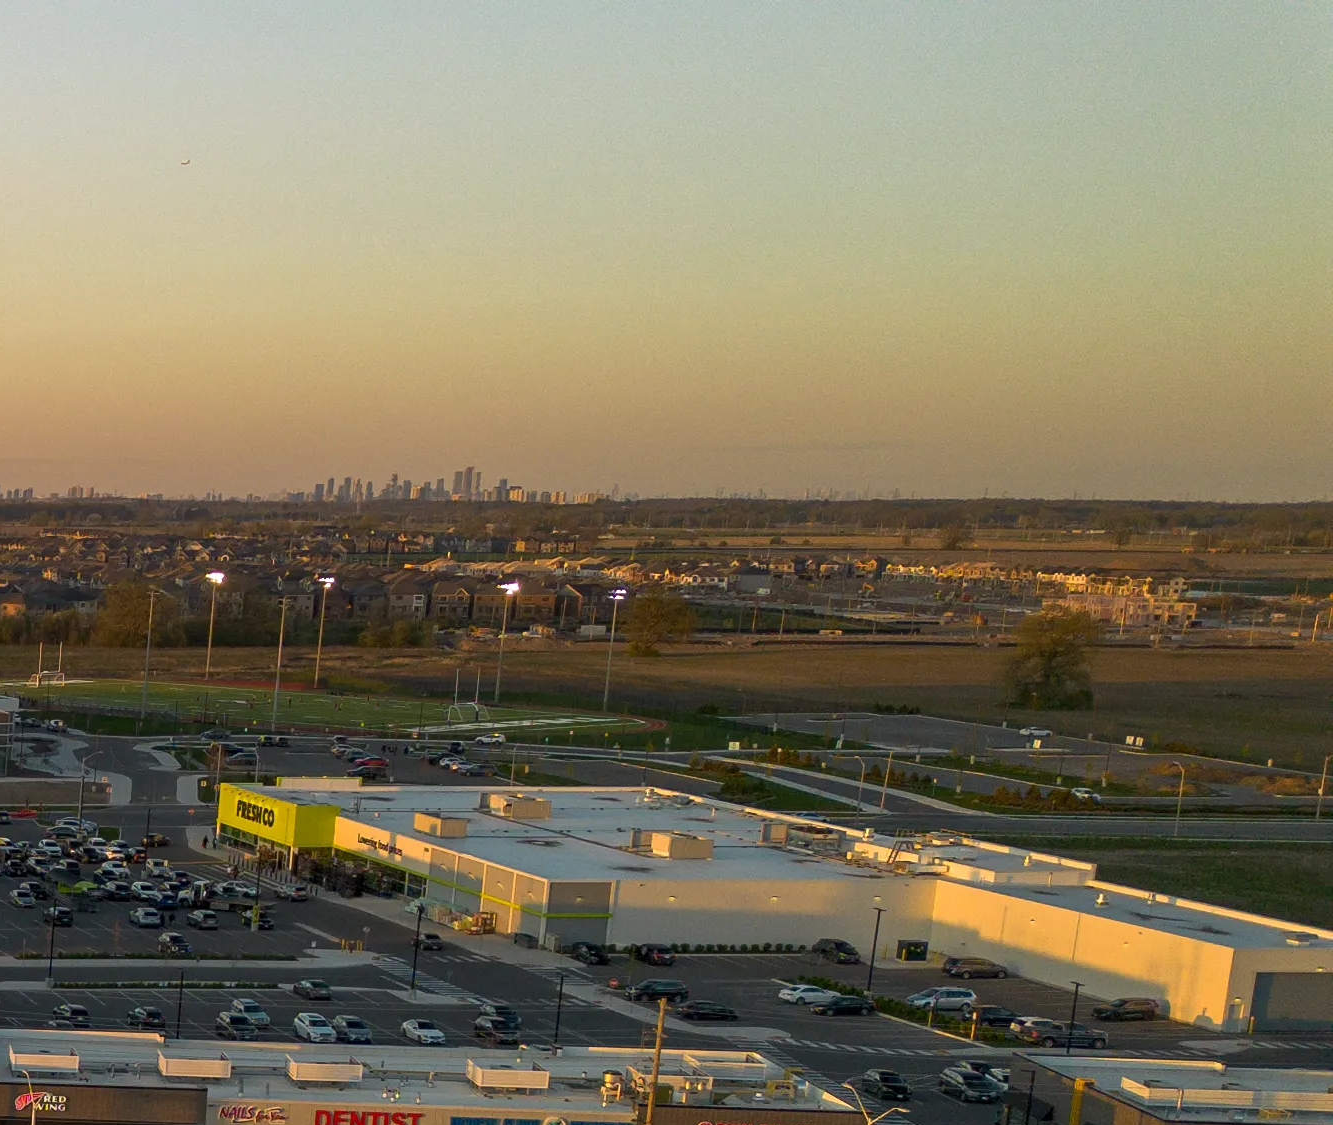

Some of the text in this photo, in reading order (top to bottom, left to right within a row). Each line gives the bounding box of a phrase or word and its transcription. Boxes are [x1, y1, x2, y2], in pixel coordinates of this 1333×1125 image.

[358, 833, 377, 850] Lowering
[378, 839, 390, 852] food
[43, 1095, 67, 1103] RED
[219, 1105, 255, 1121] NAILS
